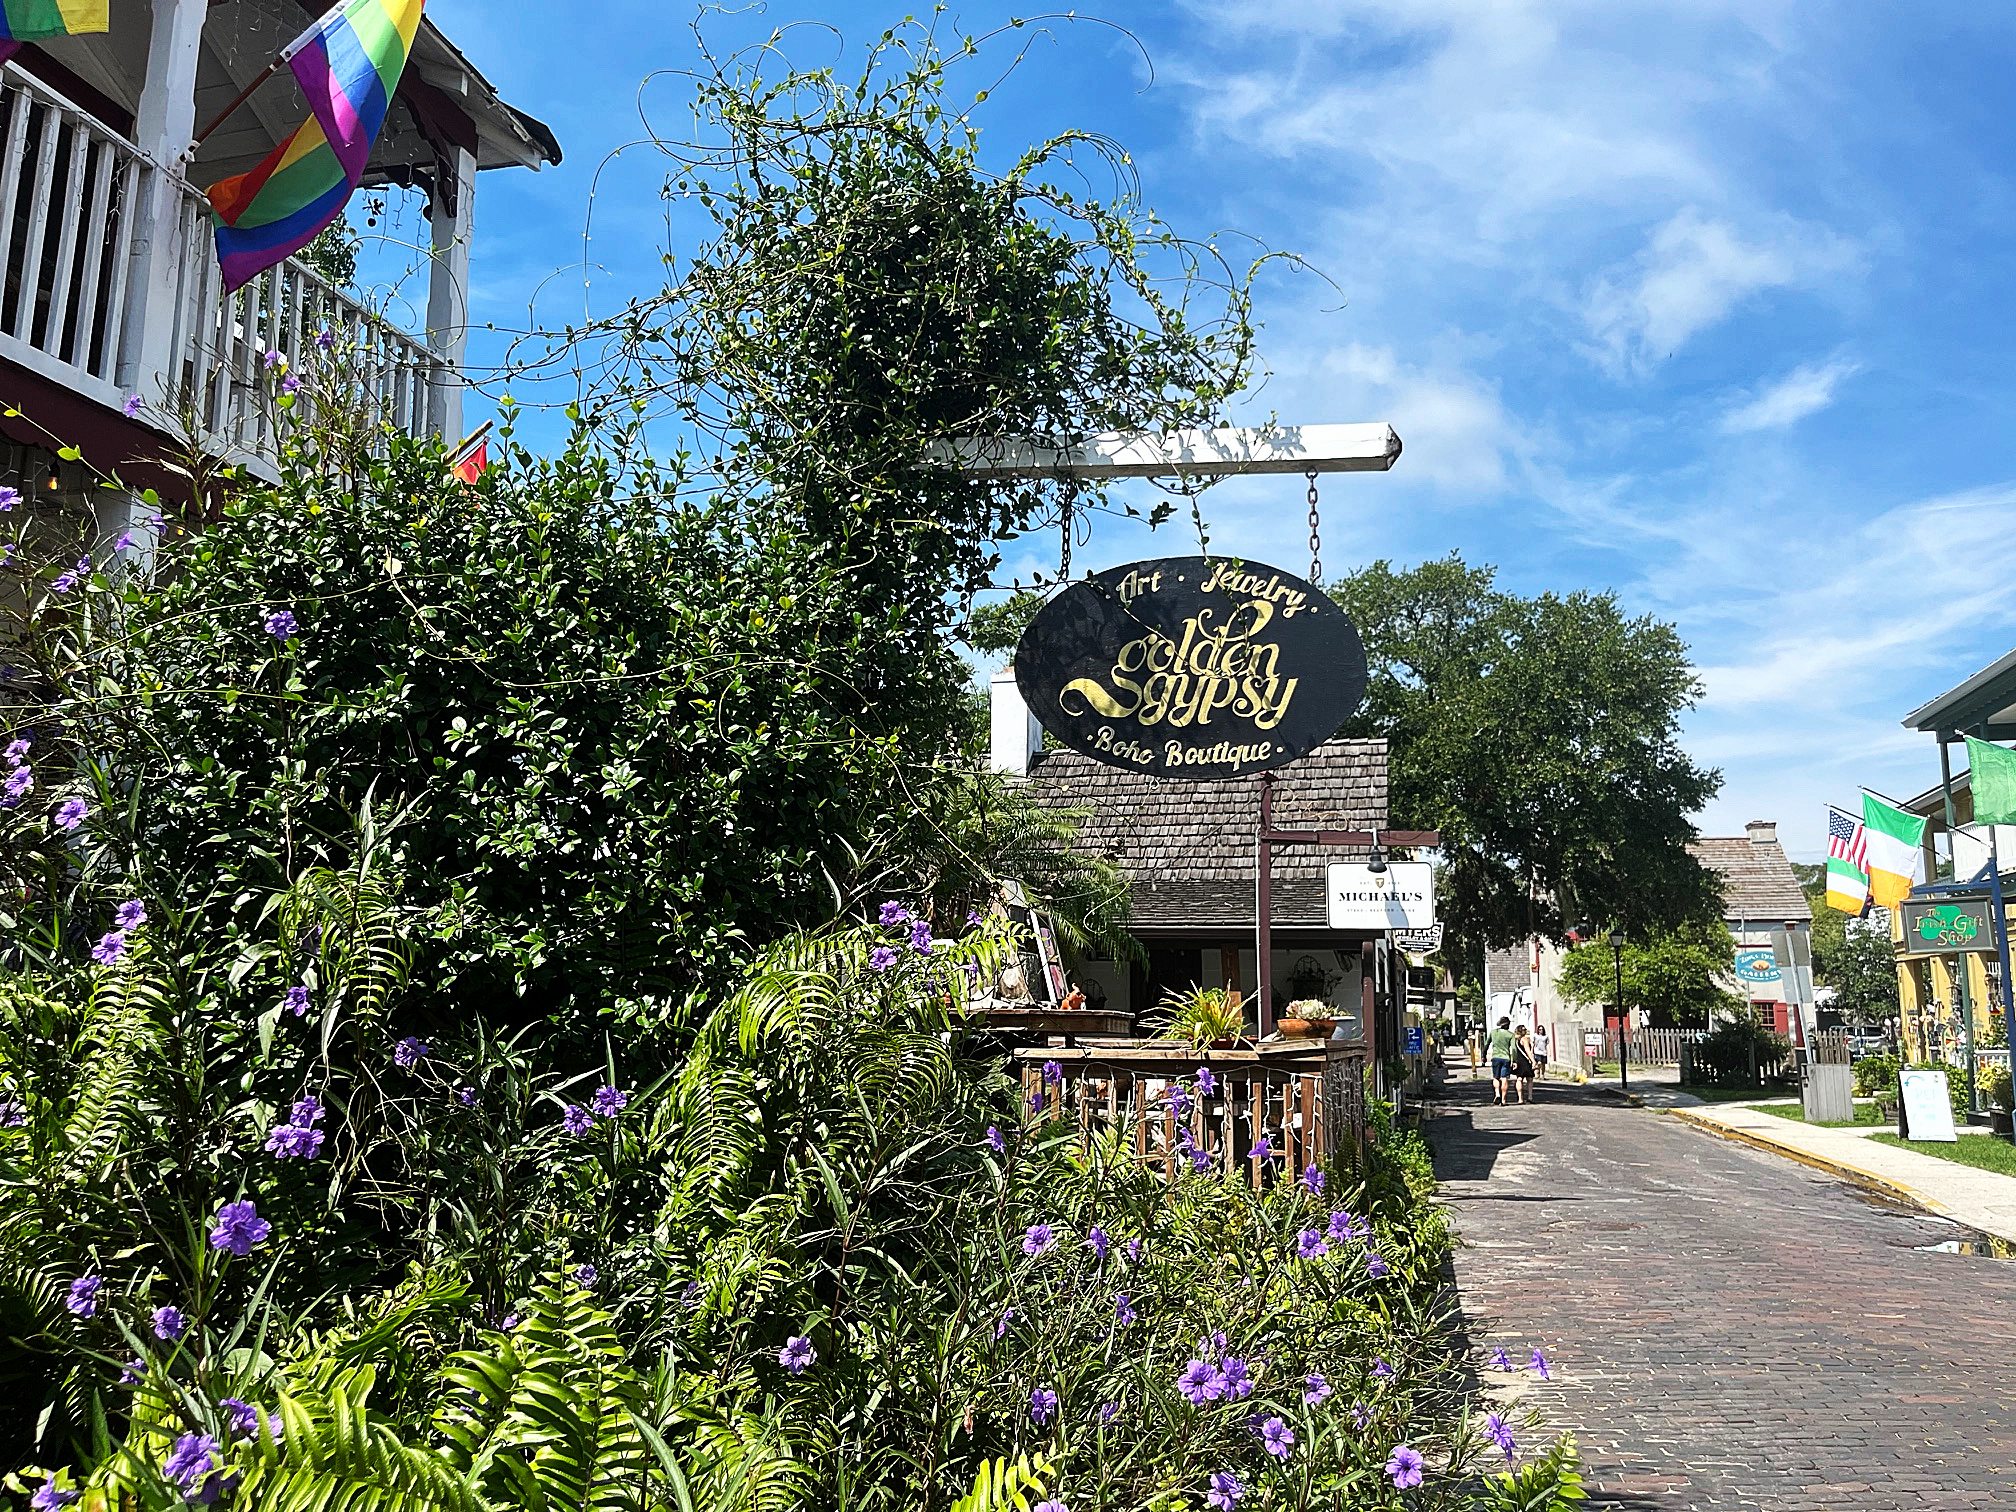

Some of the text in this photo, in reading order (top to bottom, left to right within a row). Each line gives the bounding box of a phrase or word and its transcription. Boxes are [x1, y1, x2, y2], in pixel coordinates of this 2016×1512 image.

[1116, 562, 1306, 618] Art Jewelry
[1138, 672, 1298, 730] gypsy
[1095, 726, 1271, 771] Boho Boutique
[1339, 892, 1423, 902] MICHAEL'S
[1926, 908, 1941, 917] The
[1912, 914, 1983, 933] Irish Gift
[1937, 930, 1973, 946] Shop
